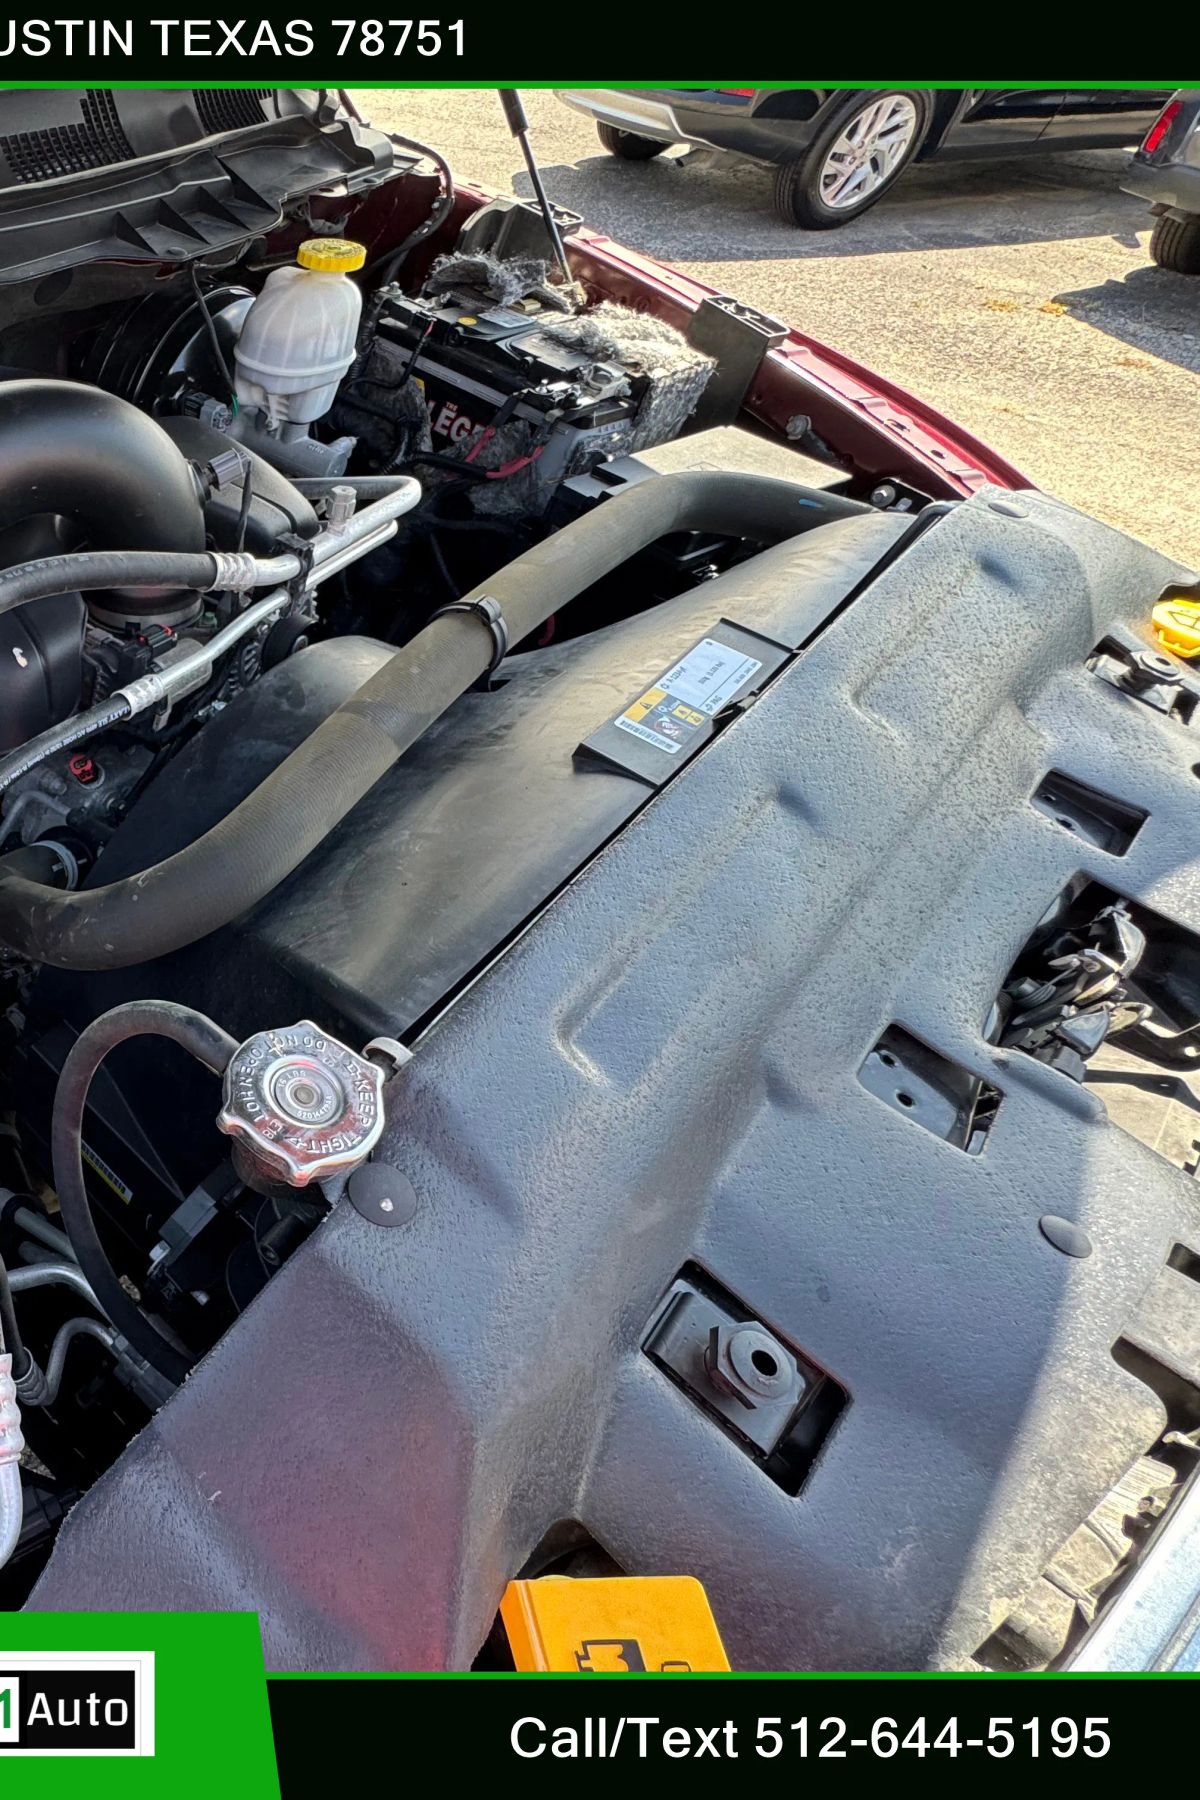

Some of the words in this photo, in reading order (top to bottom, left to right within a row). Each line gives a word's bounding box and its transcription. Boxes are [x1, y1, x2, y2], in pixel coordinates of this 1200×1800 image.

[303, 1036, 327, 1051] DO
[355, 1077, 376, 1128] KEEP
[307, 1134, 362, 1154] TIGHT
